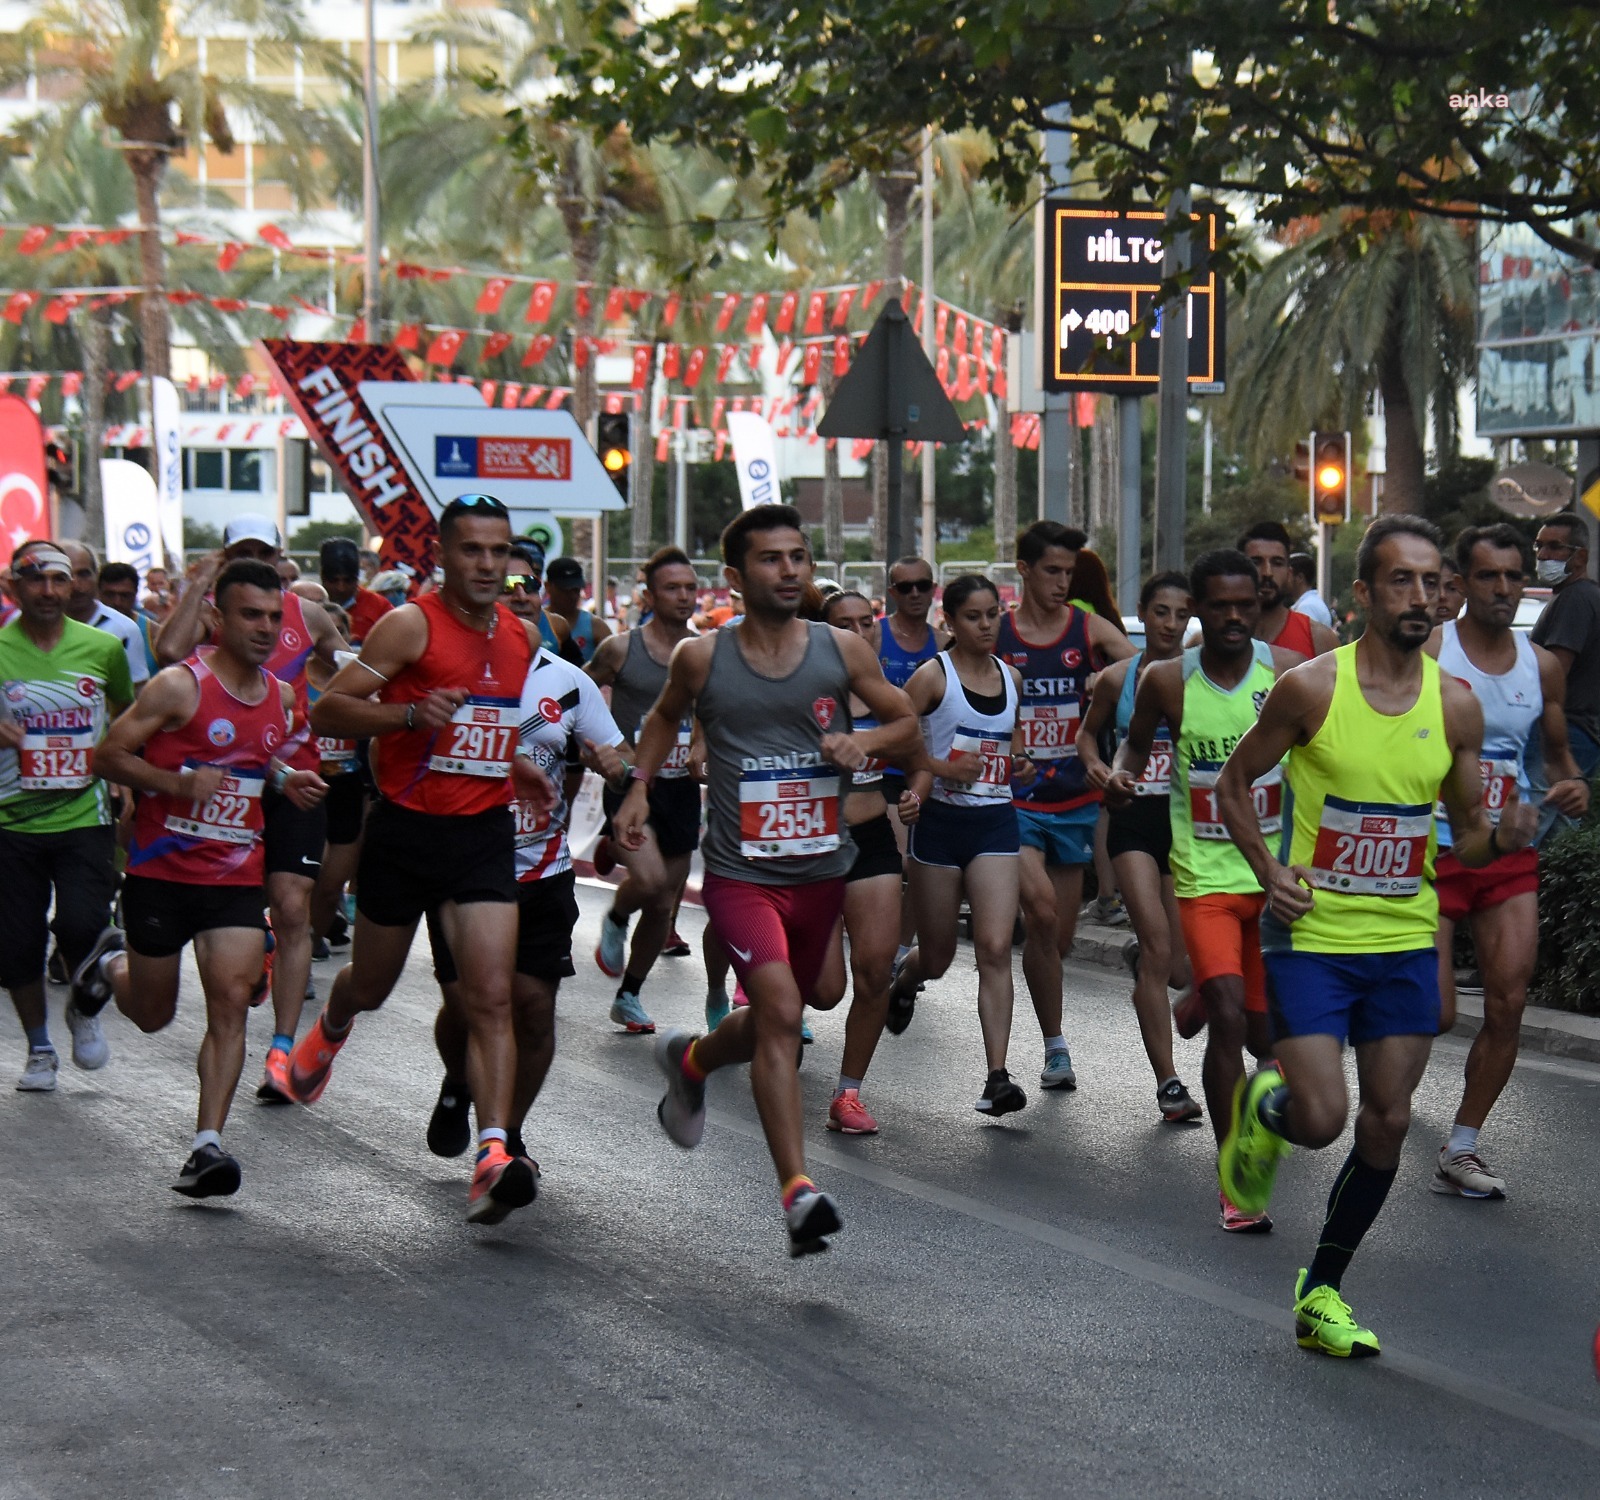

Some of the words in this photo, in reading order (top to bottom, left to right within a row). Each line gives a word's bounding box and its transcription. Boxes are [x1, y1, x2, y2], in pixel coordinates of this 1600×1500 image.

[1085, 309, 1129, 334] 400
[298, 365, 408, 508] FINISH
[450, 725, 511, 760] 2917
[1021, 721, 1069, 746] 1287
[32, 750, 88, 776] 3124
[190, 793, 251, 828] 1622
[758, 800, 827, 839] 2554
[1333, 835, 1413, 876] 2009
